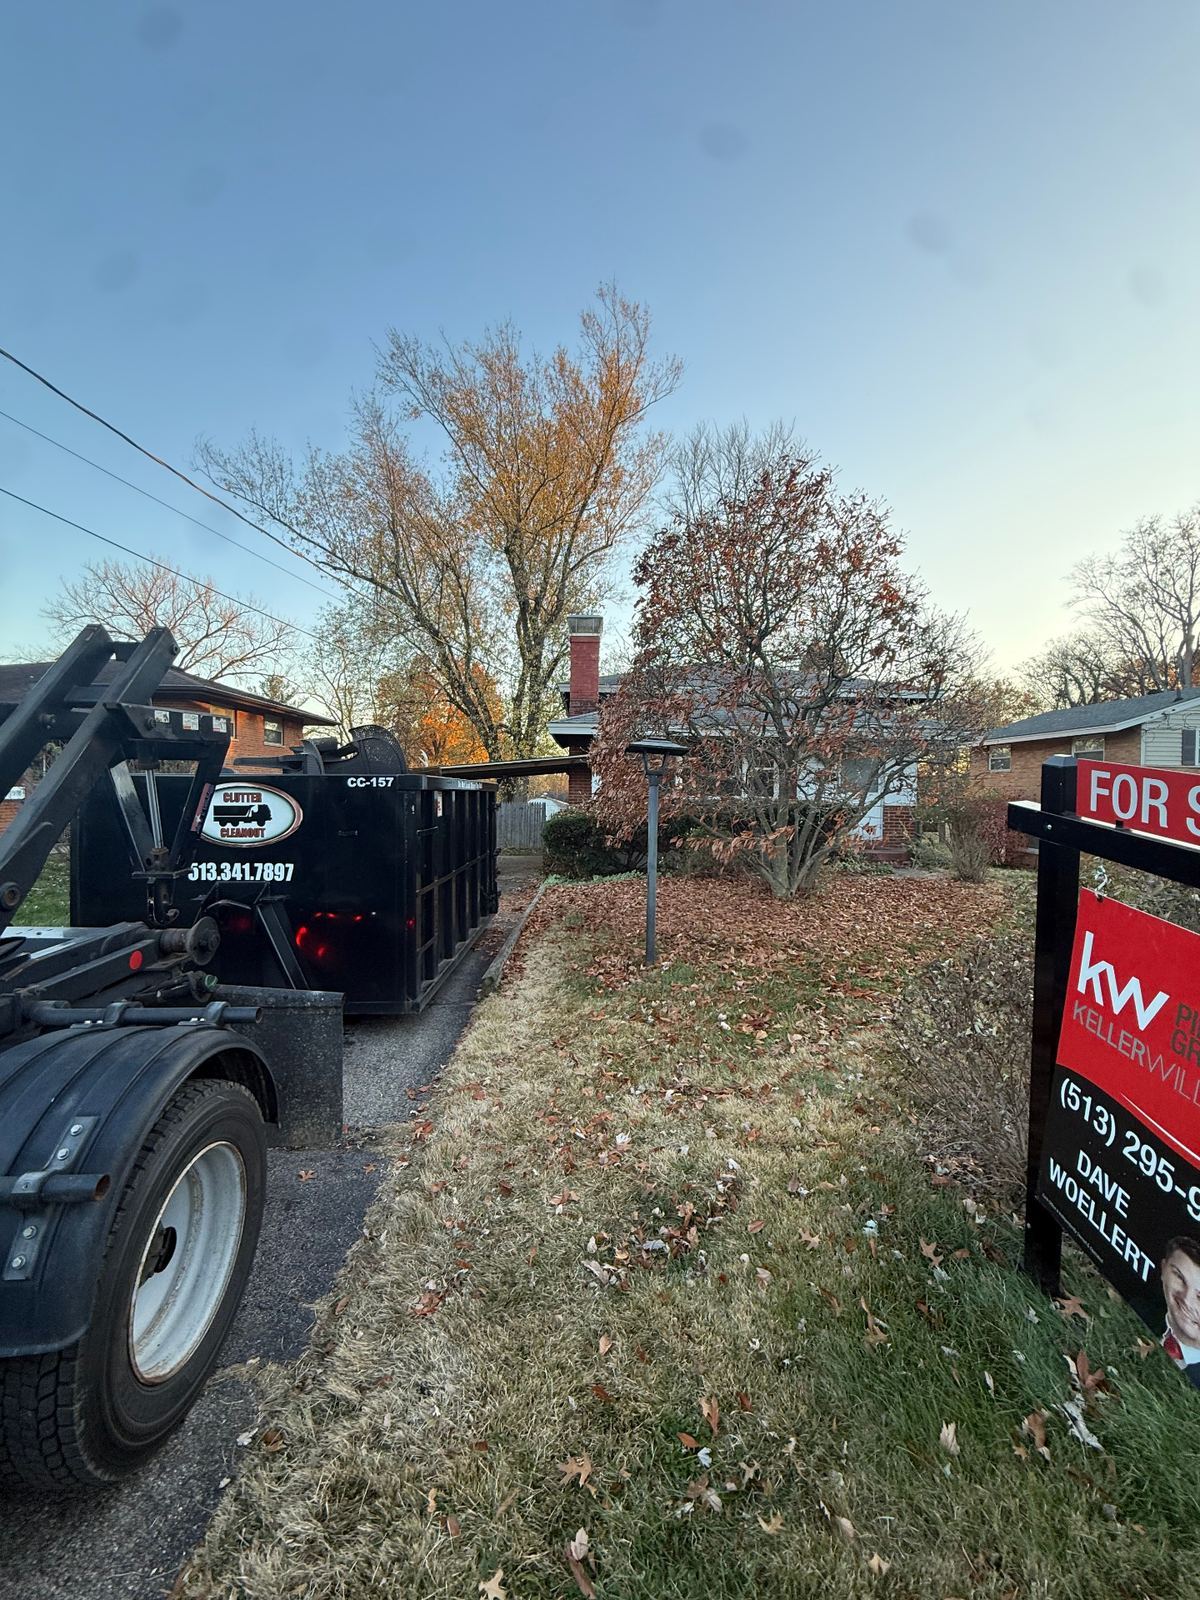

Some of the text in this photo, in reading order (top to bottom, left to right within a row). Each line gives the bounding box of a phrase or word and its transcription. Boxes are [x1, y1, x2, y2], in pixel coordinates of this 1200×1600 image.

[223, 792, 262, 803] CLUTTER
[347, 777, 394, 788] CC-157
[1090, 769, 1169, 828] FOR
[220, 827, 265, 838] CLEANOUT
[188, 862, 294, 882] 513.341.7897
[1077, 930, 1170, 1031] kw
[1060, 1077, 1116, 1147] (513)
[1076, 1149, 1131, 1219] DAVE
[1049, 1156, 1156, 1282] WOELLERT
